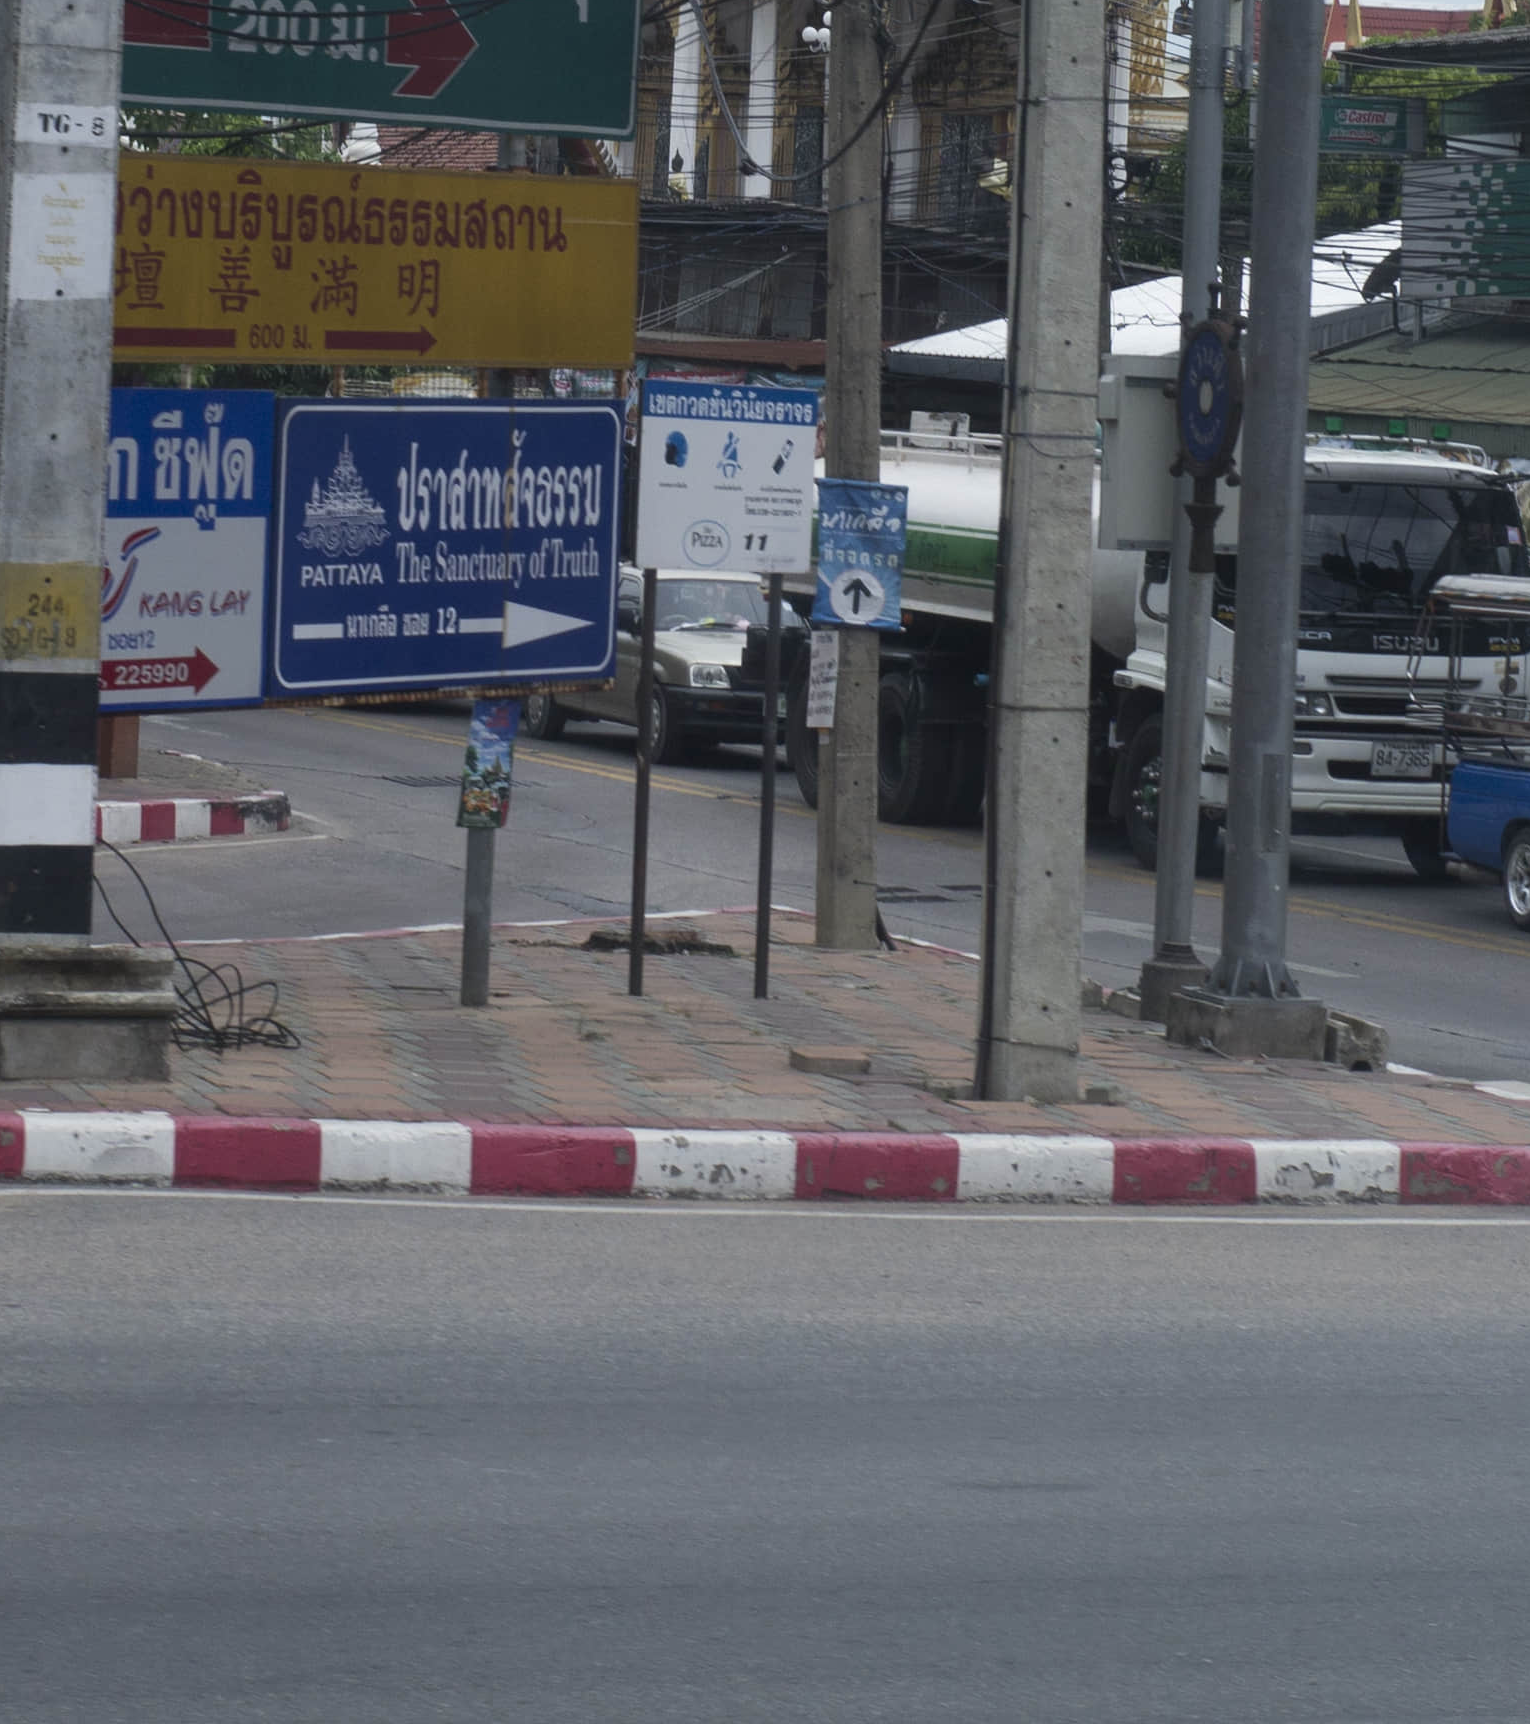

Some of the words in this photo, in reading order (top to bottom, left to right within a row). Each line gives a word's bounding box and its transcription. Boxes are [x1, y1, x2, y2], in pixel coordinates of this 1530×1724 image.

[1348, 109, 1387, 124] Castrol
[248, 324, 285, 350] 600
[397, 428, 603, 532] ปราสาทสัจธรรม
[300, 563, 385, 588] PATTAYA
[396, 541, 432, 584] The
[435, 539, 526, 589] Sanctuary
[529, 538, 550, 579] of
[550, 537, 600, 578] Truth
[138, 591, 203, 618] KANG
[209, 590, 252, 617] LAY
[346, 604, 398, 639] นาเกลือ
[403, 614, 430, 637] ซอย
[435, 606, 457, 635] 12
[1372, 634, 1440, 652] ISUZU
[114, 662, 190, 686] 225990
